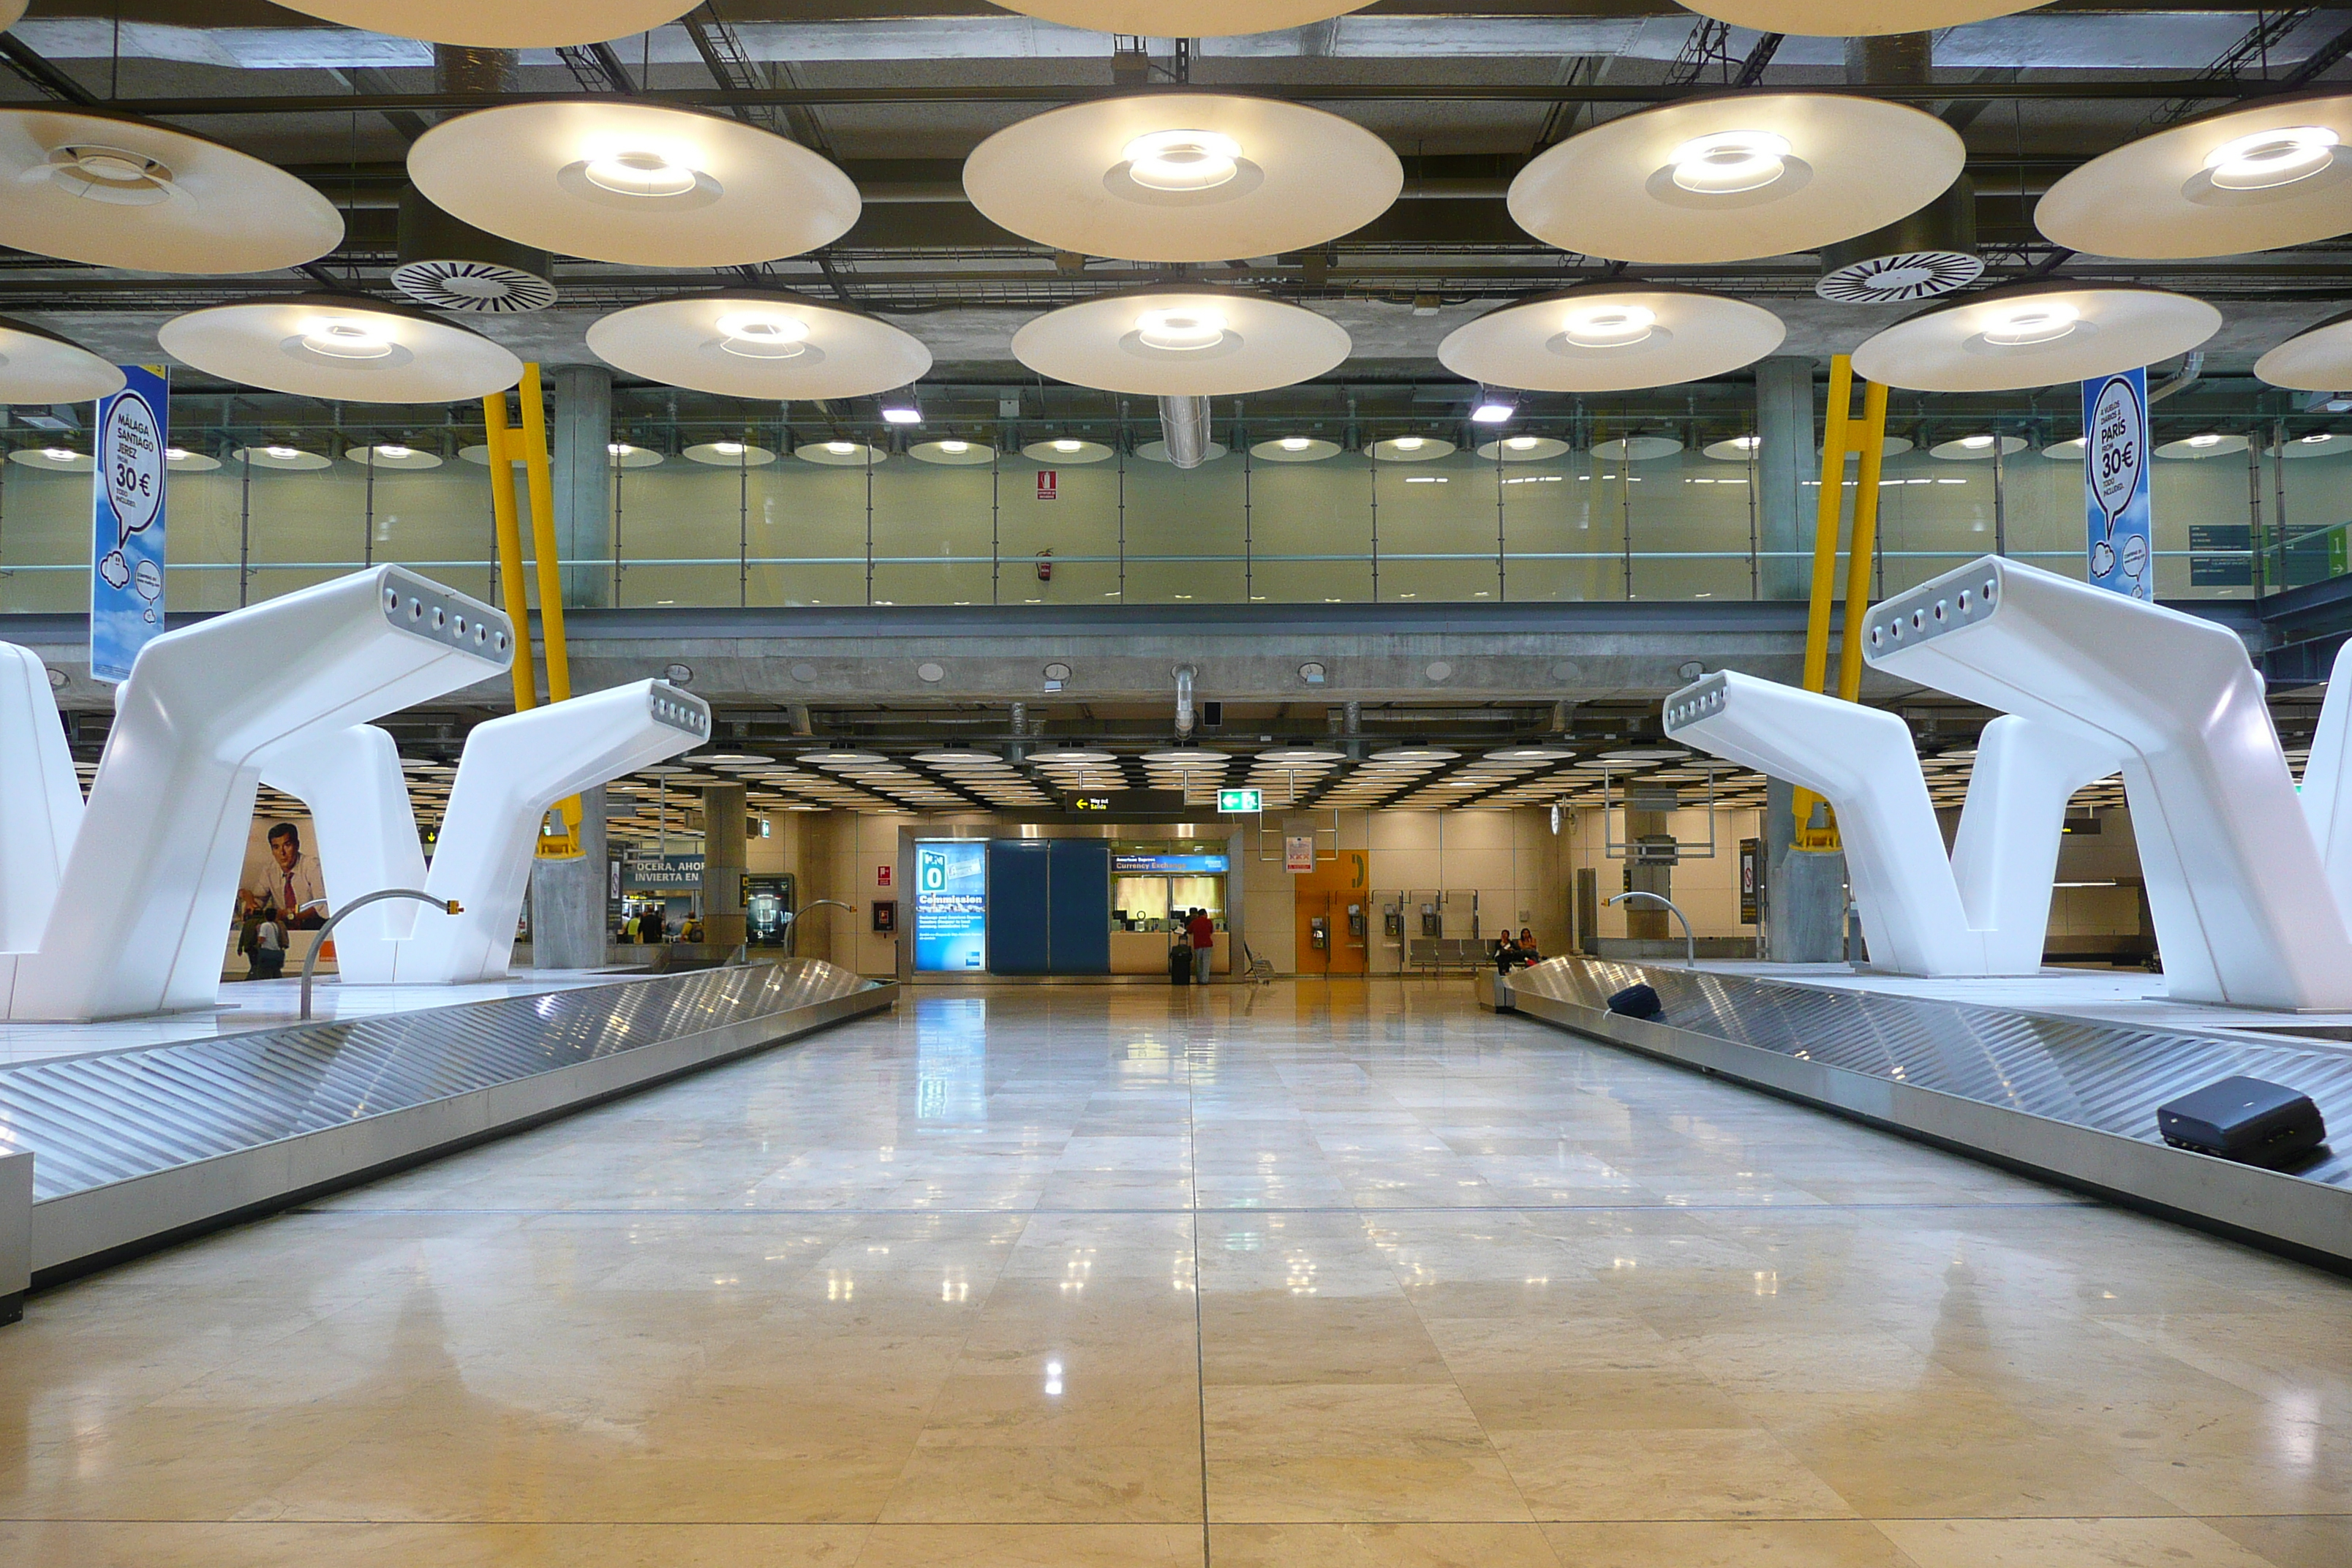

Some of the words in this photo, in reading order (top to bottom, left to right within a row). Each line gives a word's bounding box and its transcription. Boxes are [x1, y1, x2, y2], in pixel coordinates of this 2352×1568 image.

[118, 412, 150, 437] MÁLAGA
[2101, 415, 2126, 445] PARÍS
[117, 427, 154, 453] SANTIAGO
[117, 442, 137, 460] JEREZ
[116, 463, 137, 492] 30
[635, 872, 682, 882] INVIERTA
[685, 872, 699, 881] EN
[1116, 862, 1150, 870] Currency
[1151, 862, 1186, 870] Exchange
[927, 867, 943, 889] 0
[919, 894, 983, 904] Commission
